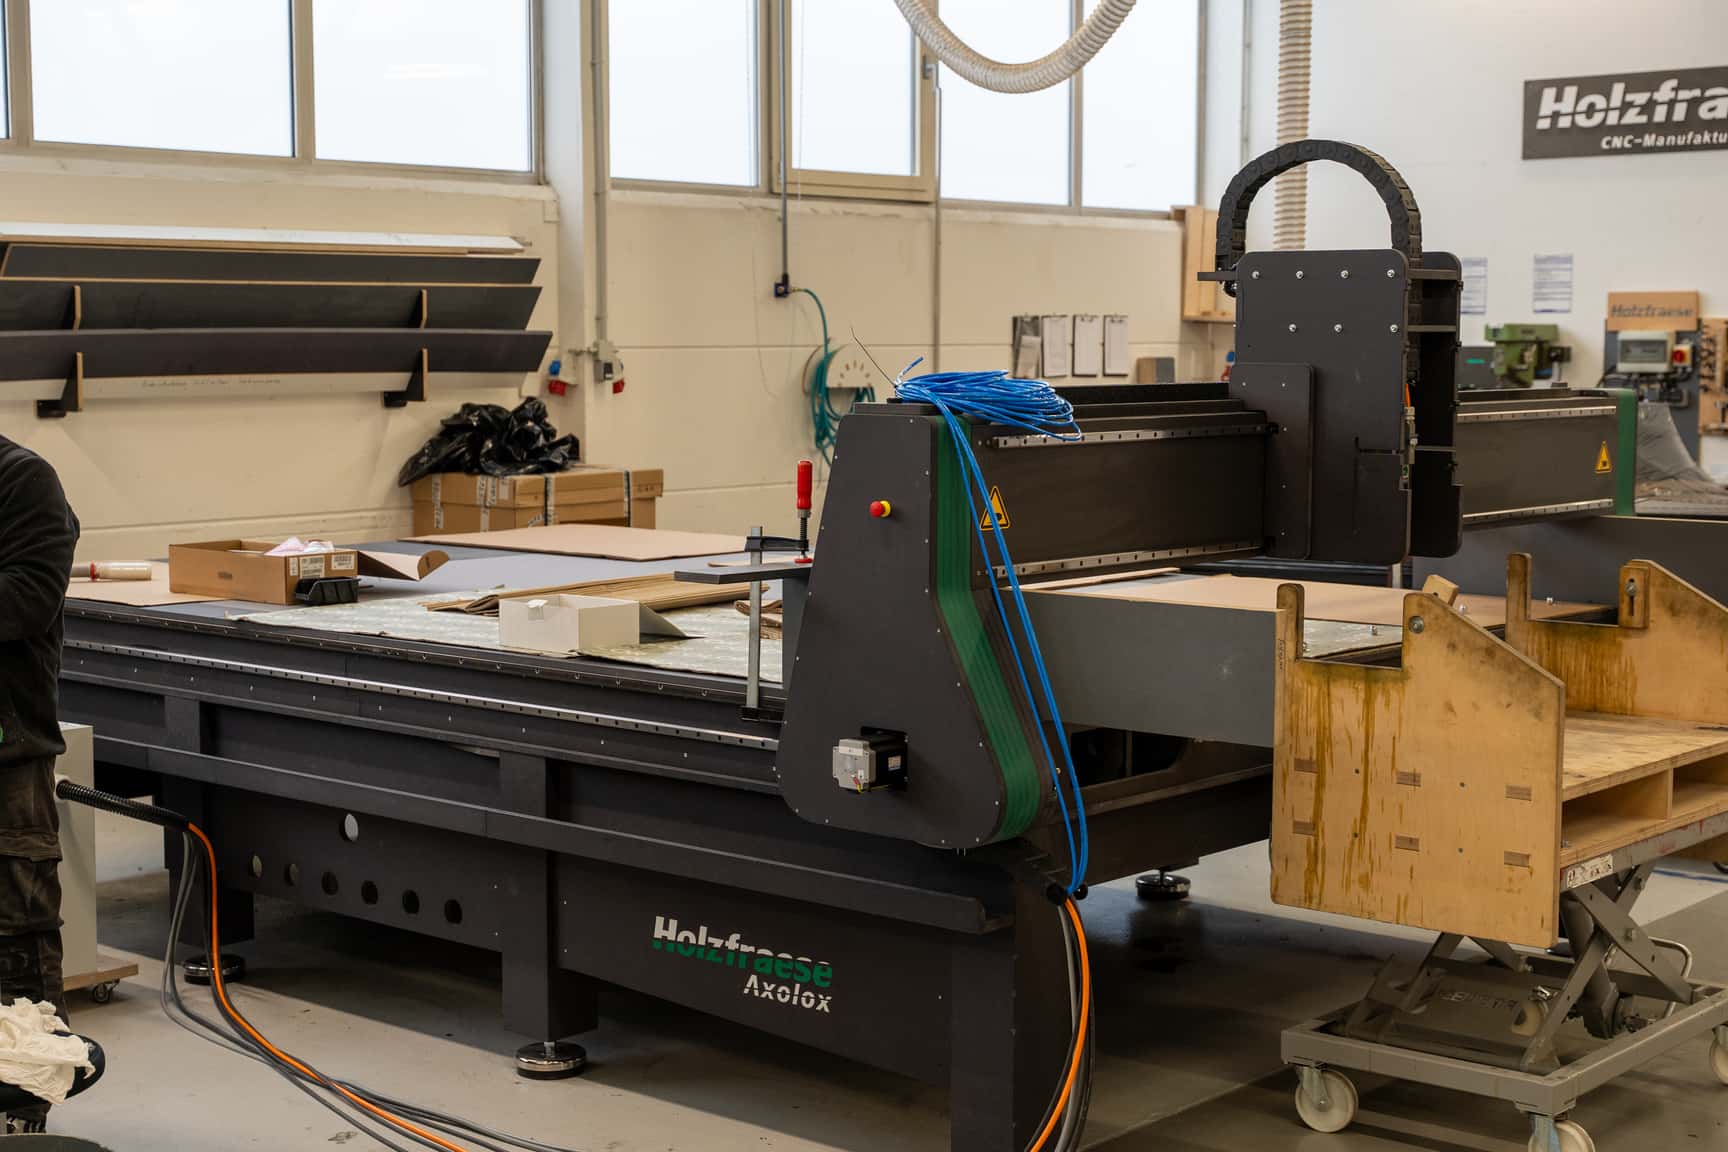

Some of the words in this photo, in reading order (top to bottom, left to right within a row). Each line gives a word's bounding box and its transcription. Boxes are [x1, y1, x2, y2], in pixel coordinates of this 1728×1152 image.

[1601, 131, 1728, 149] CNC-Manufaktu
[650, 915, 833, 988] Holzfraese
[743, 974, 832, 1013] Axolox
